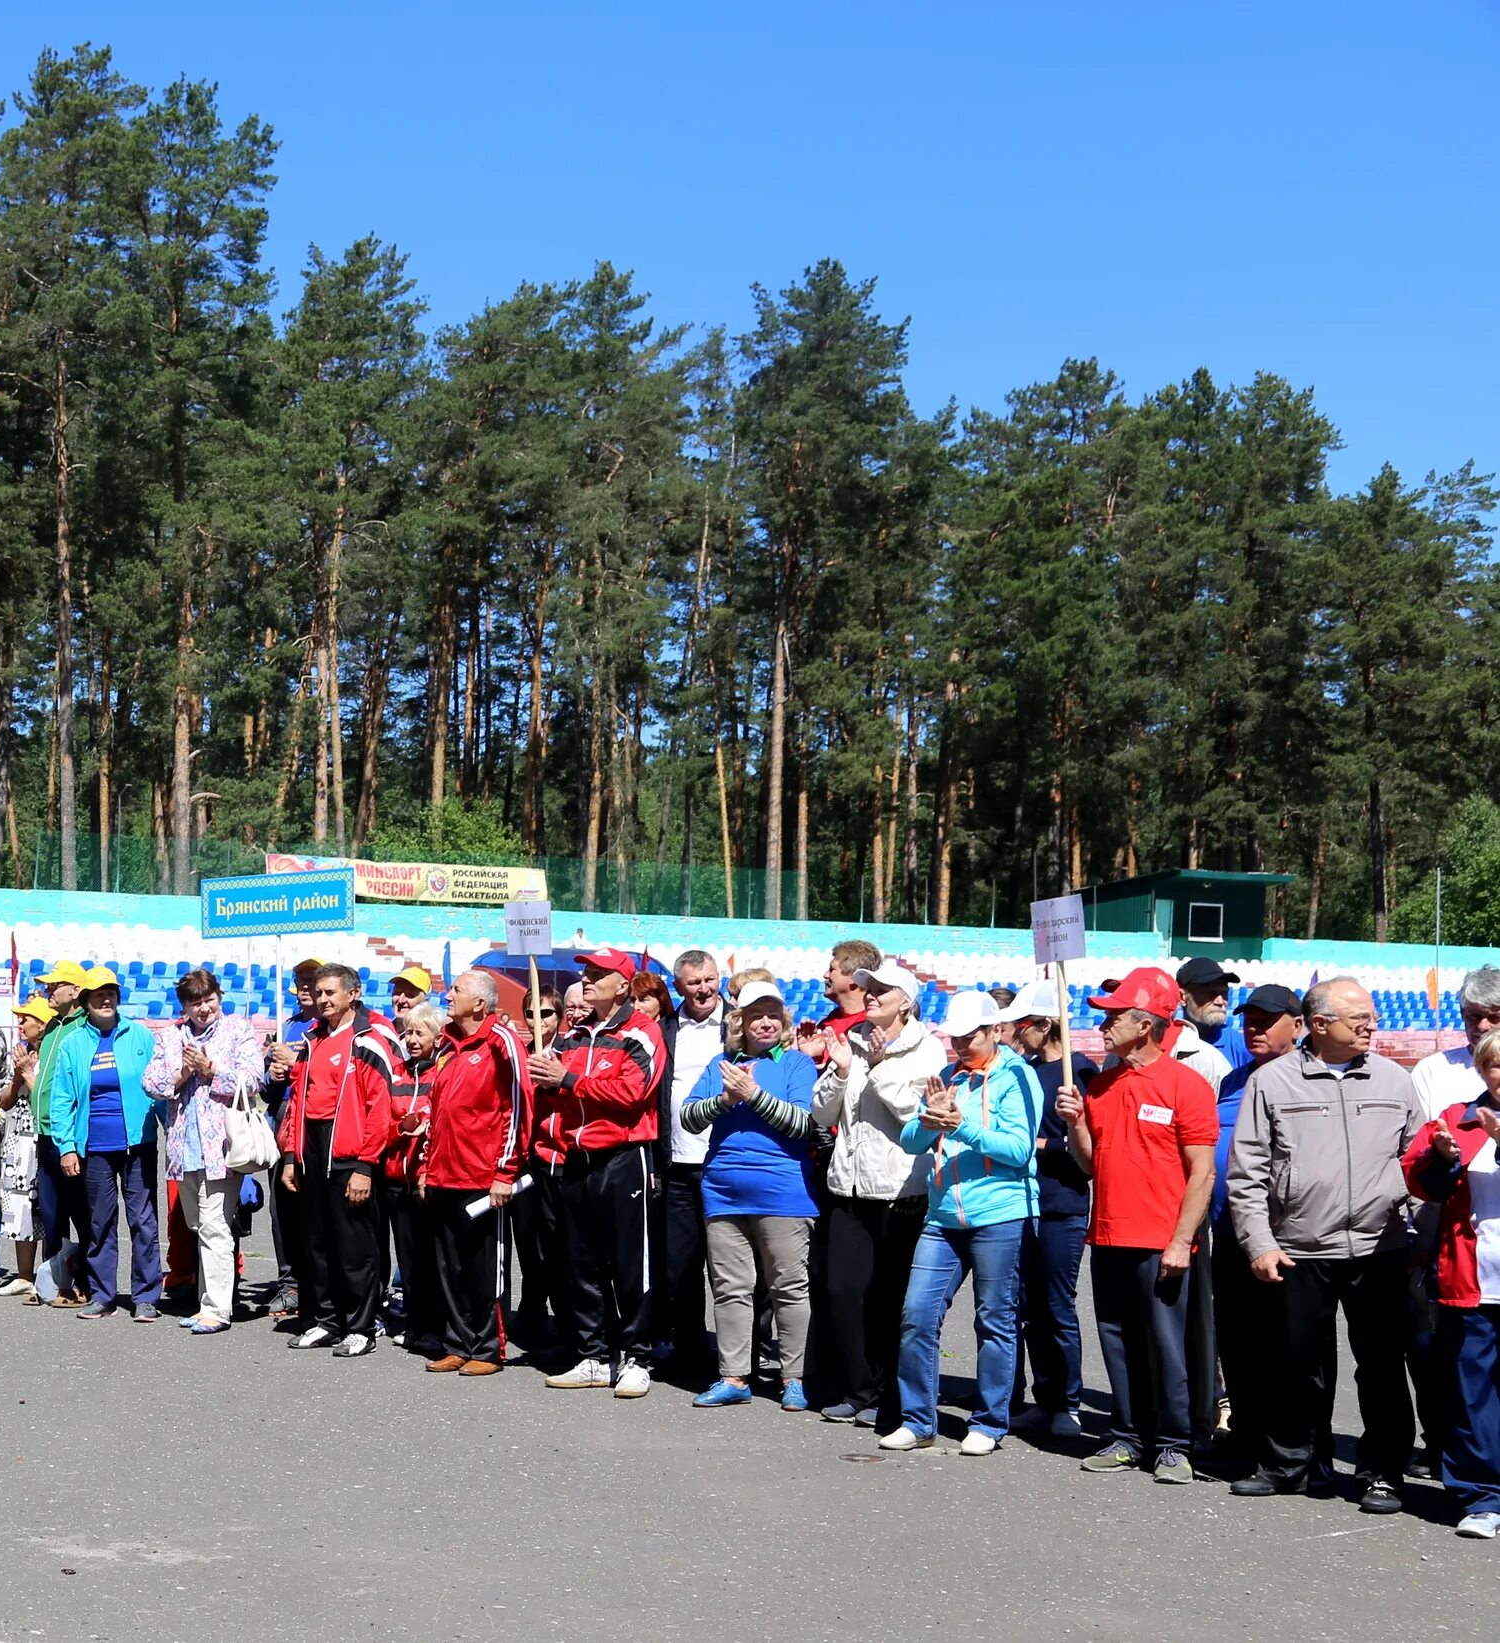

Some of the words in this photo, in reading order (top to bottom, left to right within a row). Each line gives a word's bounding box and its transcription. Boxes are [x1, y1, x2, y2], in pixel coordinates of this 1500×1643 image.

[356, 864, 421, 880] МИНСПОРТ
[452, 869, 508, 878] РОССИЙСКАЯ
[366, 880, 414, 897] РОССИИ
[453, 880, 508, 890] ФЕДЕРАЦИЯ
[451, 891, 509, 900] БАСКЕТБОЛА
[215, 894, 288, 920] Брянский
[293, 891, 339, 916] район
[509, 916, 548, 926] ФОКИНСКИЙ
[1036, 914, 1079, 929] Водарский
[519, 927, 540, 936] РАЙОН
